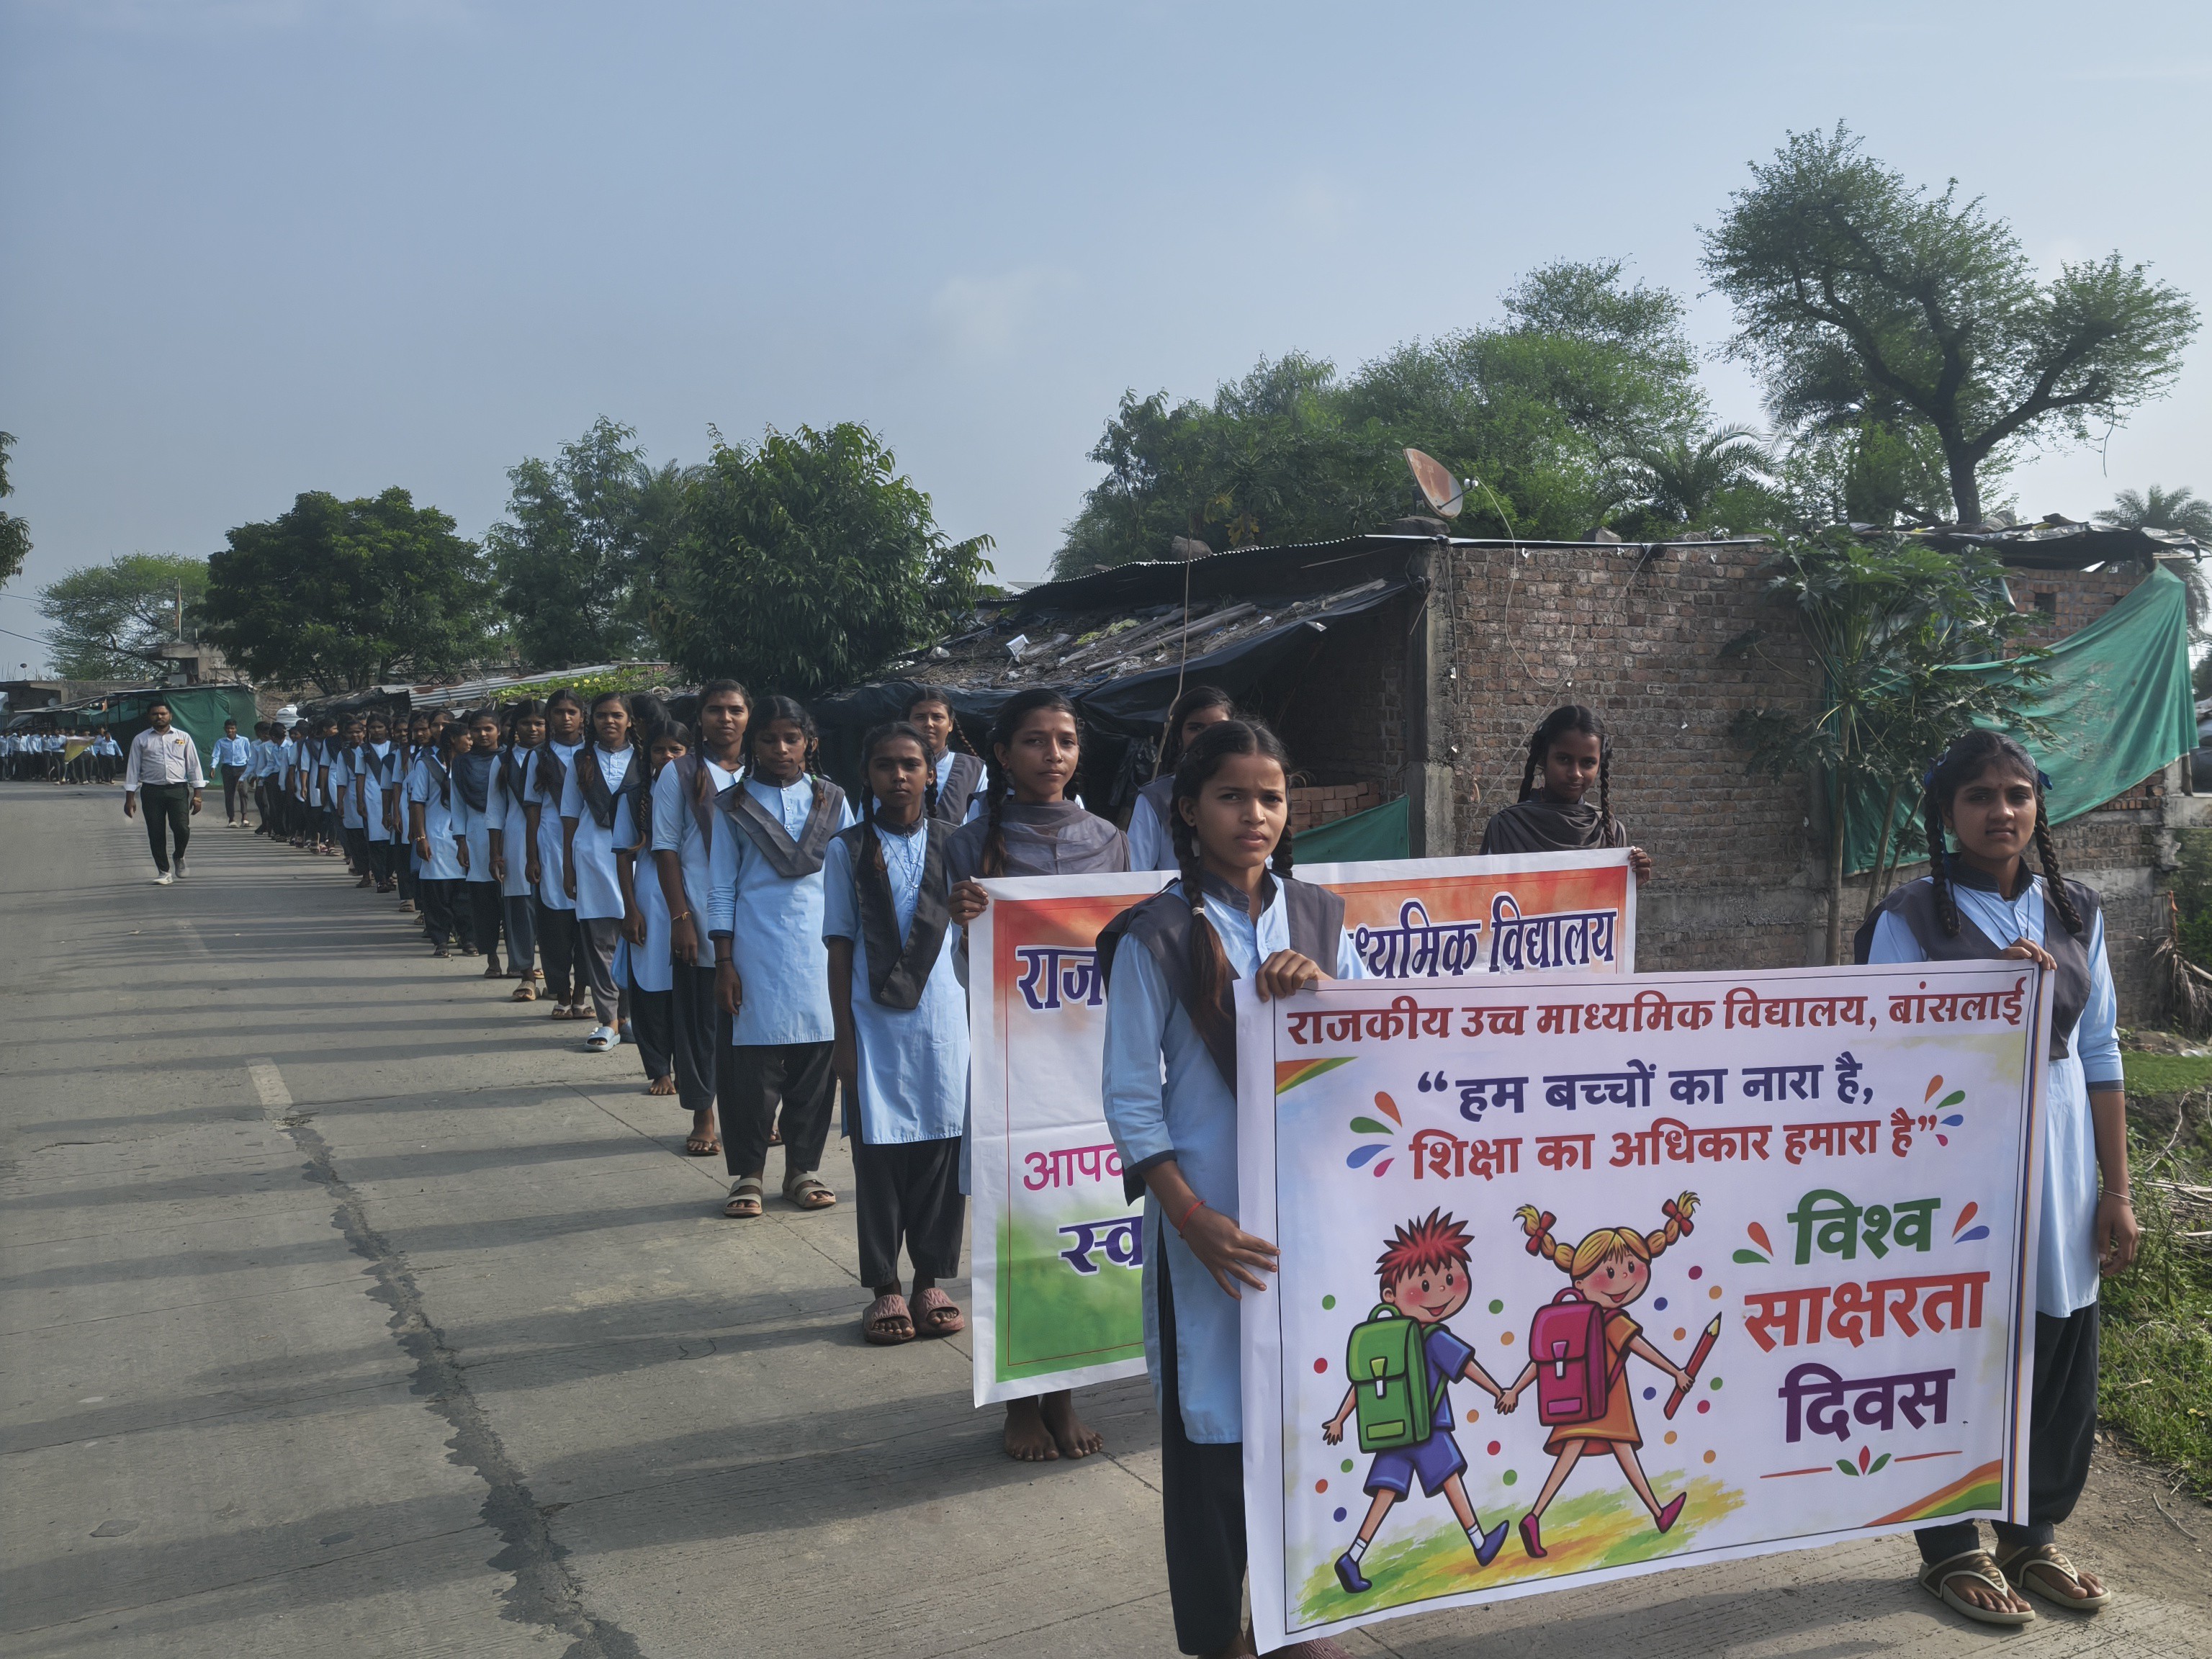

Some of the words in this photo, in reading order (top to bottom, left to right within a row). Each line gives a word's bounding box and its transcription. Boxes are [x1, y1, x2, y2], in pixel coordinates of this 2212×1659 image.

[1016, 948, 1103, 1011] राज
[1347, 900, 1481, 980] ध्यमिक
[1488, 894, 1617, 974] विद्यालय
[1286, 994, 1454, 1045] राजकीय
[1460, 1005, 1529, 1035] उच्च
[1537, 990, 1716, 1035] माध्यमिक
[1723, 986, 1877, 1032] विद्यालय,
[1888, 976, 2027, 1025] बांसलाई
[1542, 1058, 1657, 1111] बच्चों
[1668, 1068, 1729, 1105] का
[1741, 1064, 1825, 1102] नारा
[1834, 1051, 1874, 1105] है,
[1408, 1128, 1523, 1182] शिक्षा
[1534, 1133, 1596, 1171] का
[1609, 1117, 1773, 1166] अधिकार
[1783, 1120, 1881, 1165] हमारा
[1058, 1215, 1143, 1274] स्व
[1786, 1188, 1941, 1265] विश्व
[1744, 1270, 1990, 1354] साक्षरता
[1778, 1362, 1956, 1444] दिवस
